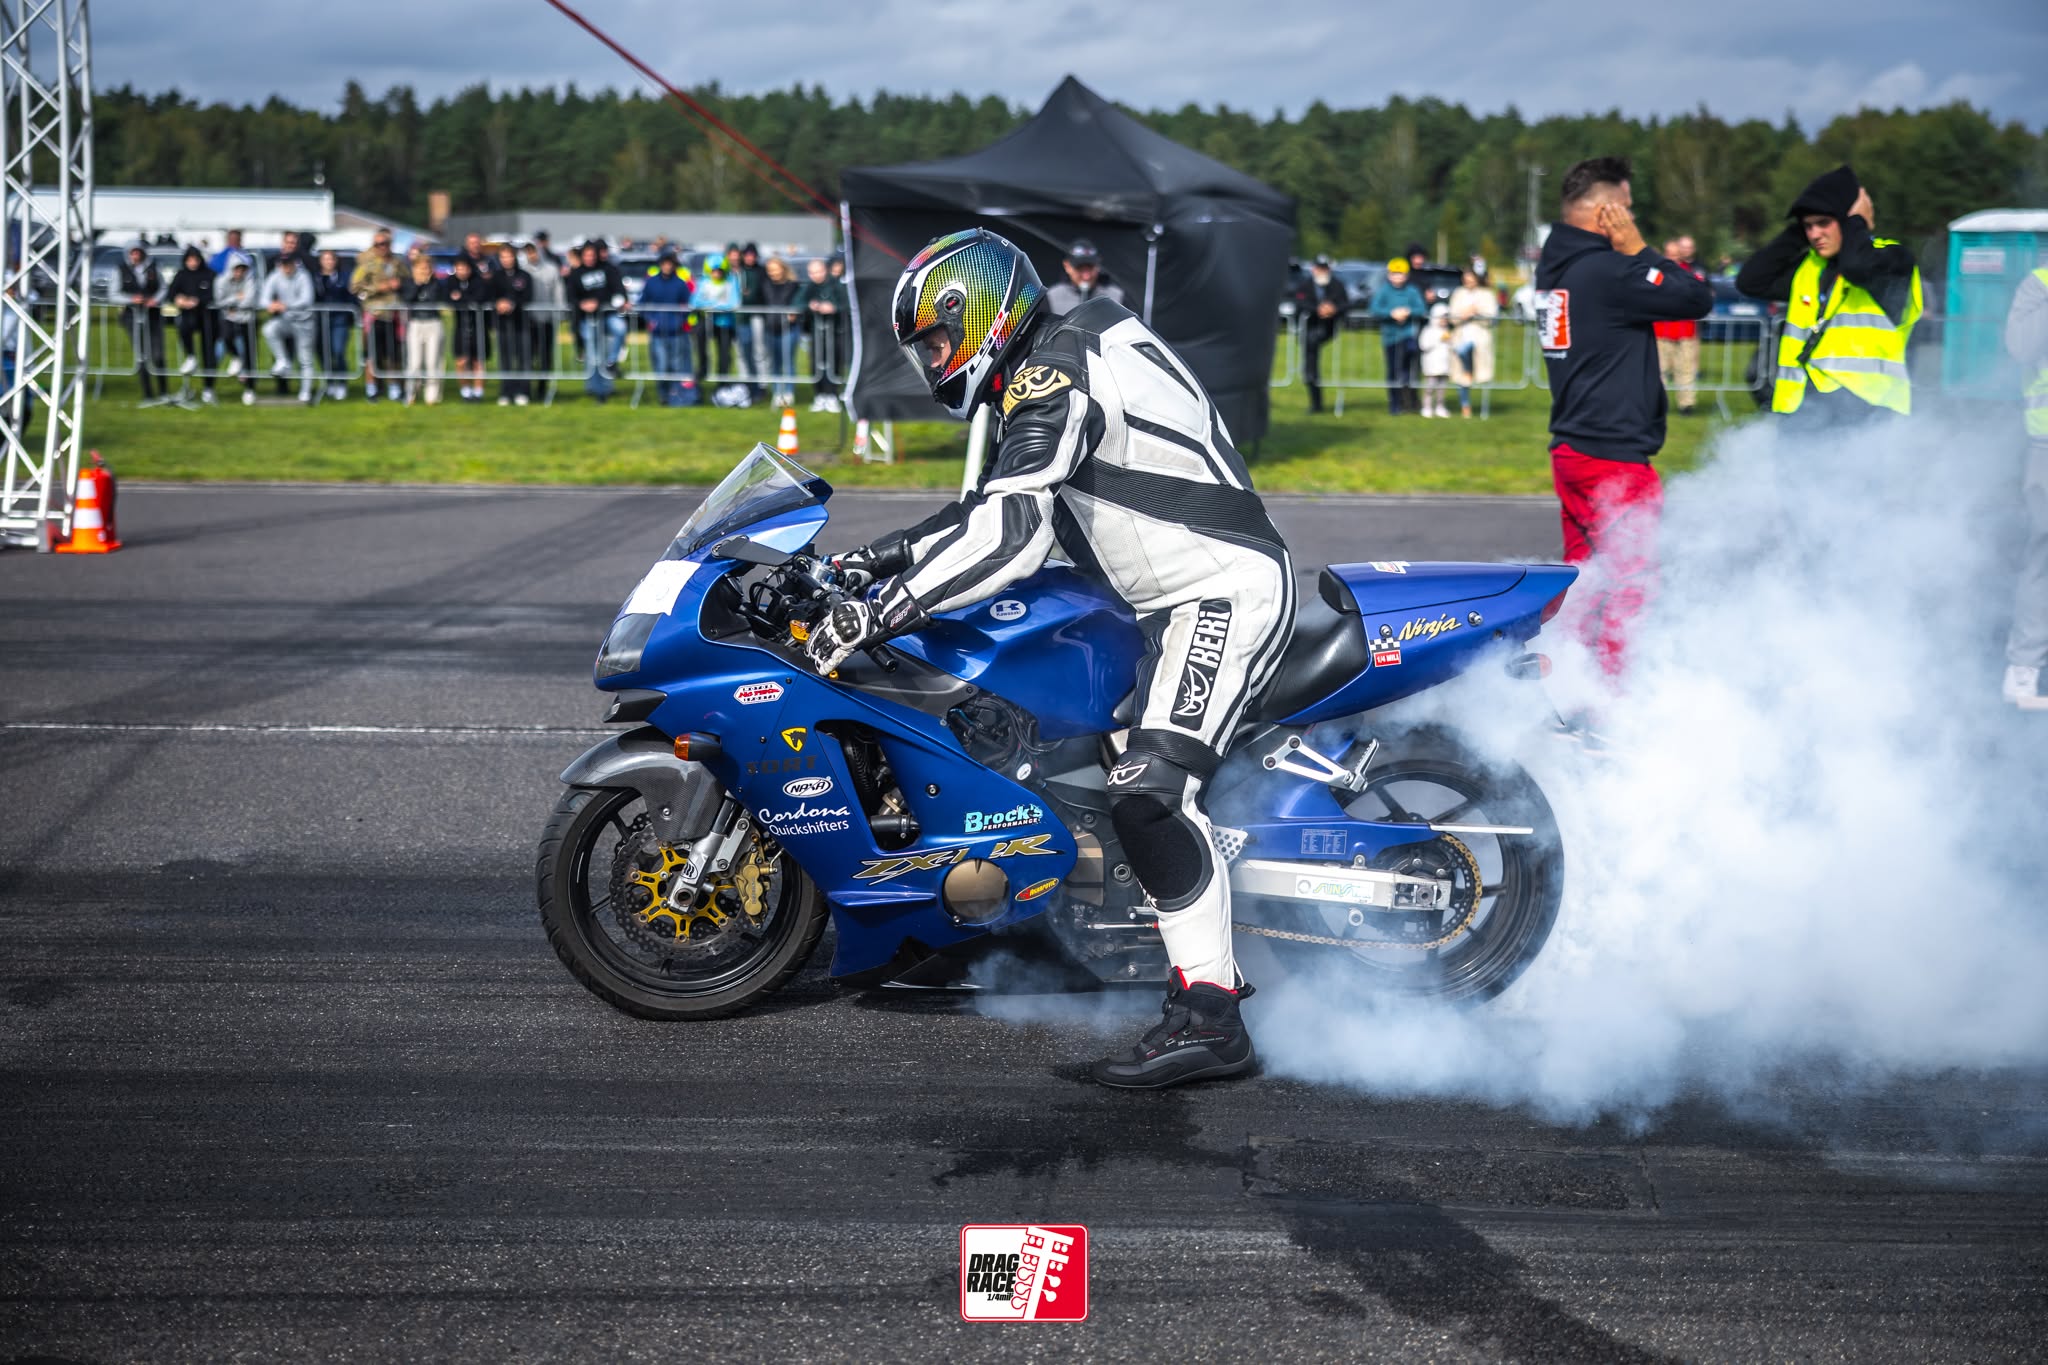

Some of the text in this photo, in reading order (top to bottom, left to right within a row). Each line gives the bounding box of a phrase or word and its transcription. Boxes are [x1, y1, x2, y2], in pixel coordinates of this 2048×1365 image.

[1399, 613, 1462, 641] Ninja
[790, 781, 826, 793] NAXA
[758, 802, 850, 823] Cordona
[965, 803, 1043, 832] Brock's
[769, 820, 850, 836] Quickshifters
[983, 818, 1038, 831] PERFORMANCE
